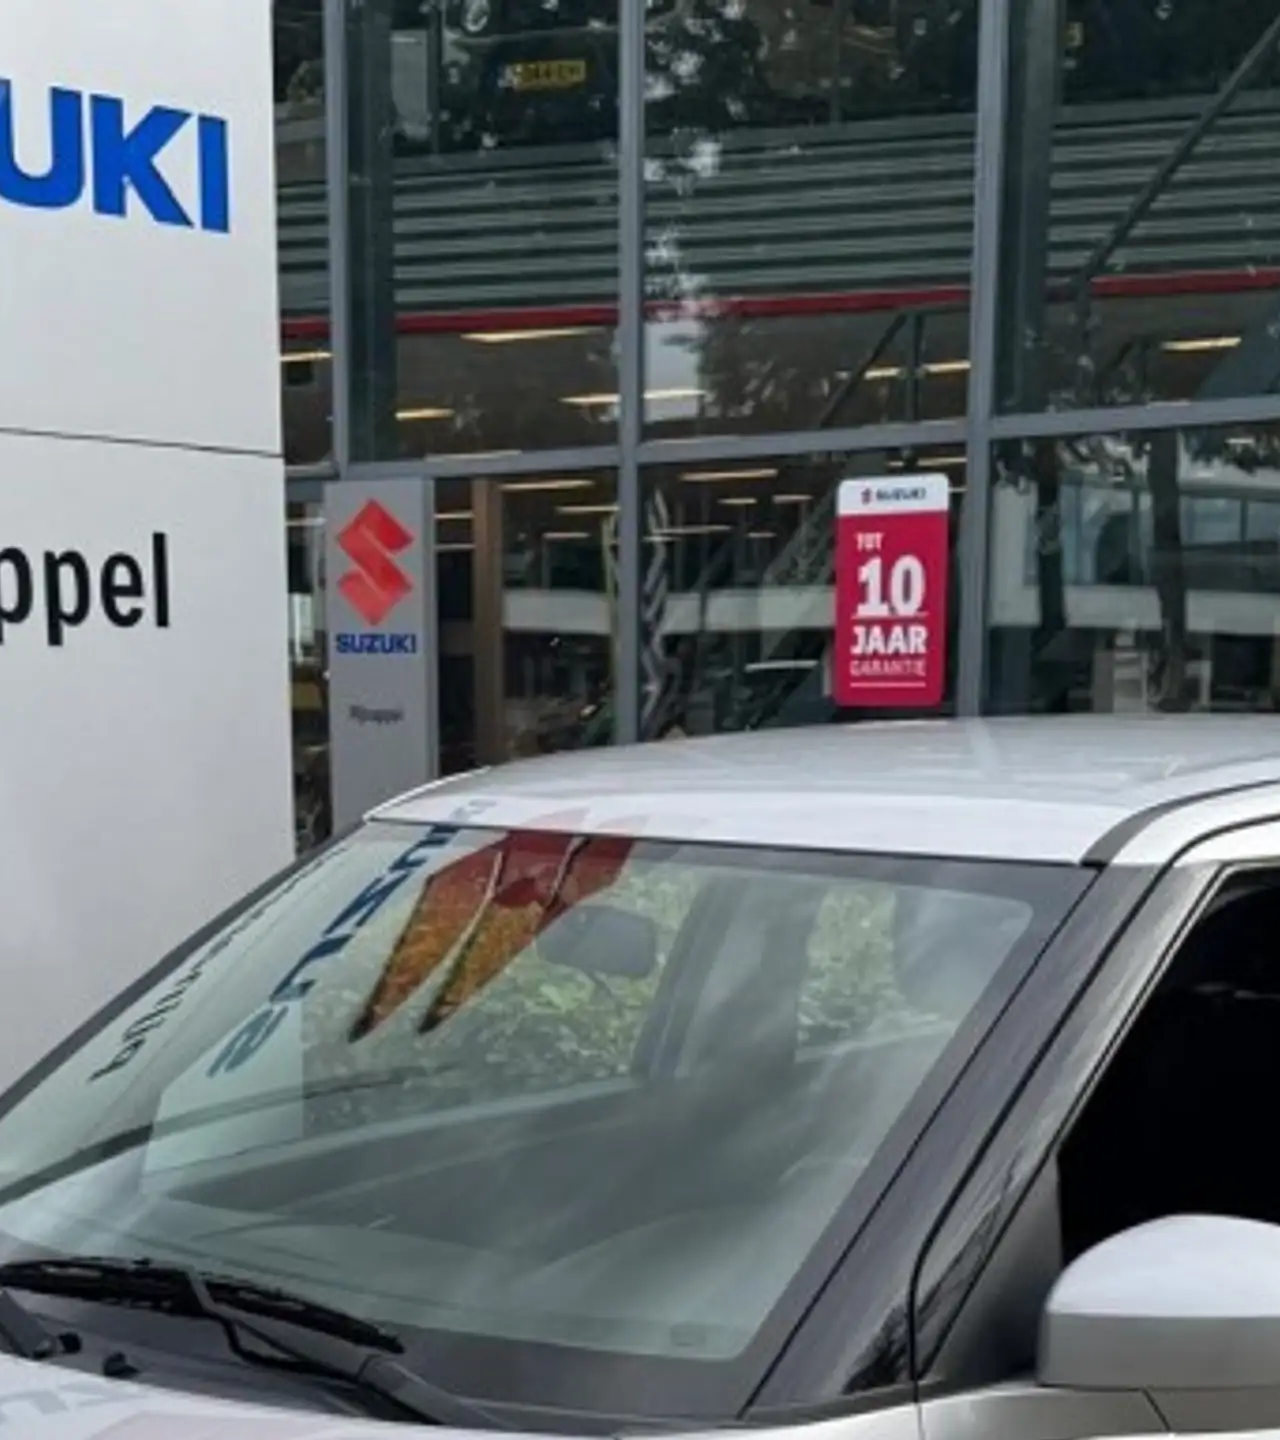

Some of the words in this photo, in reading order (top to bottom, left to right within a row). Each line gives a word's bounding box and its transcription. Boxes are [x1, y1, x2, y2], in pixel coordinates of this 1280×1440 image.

[856, 555, 926, 617] 10
[335, 632, 418, 655] SUZUKI
[851, 624, 928, 655] JAAR
[849, 658, 927, 677] GARANTIE
